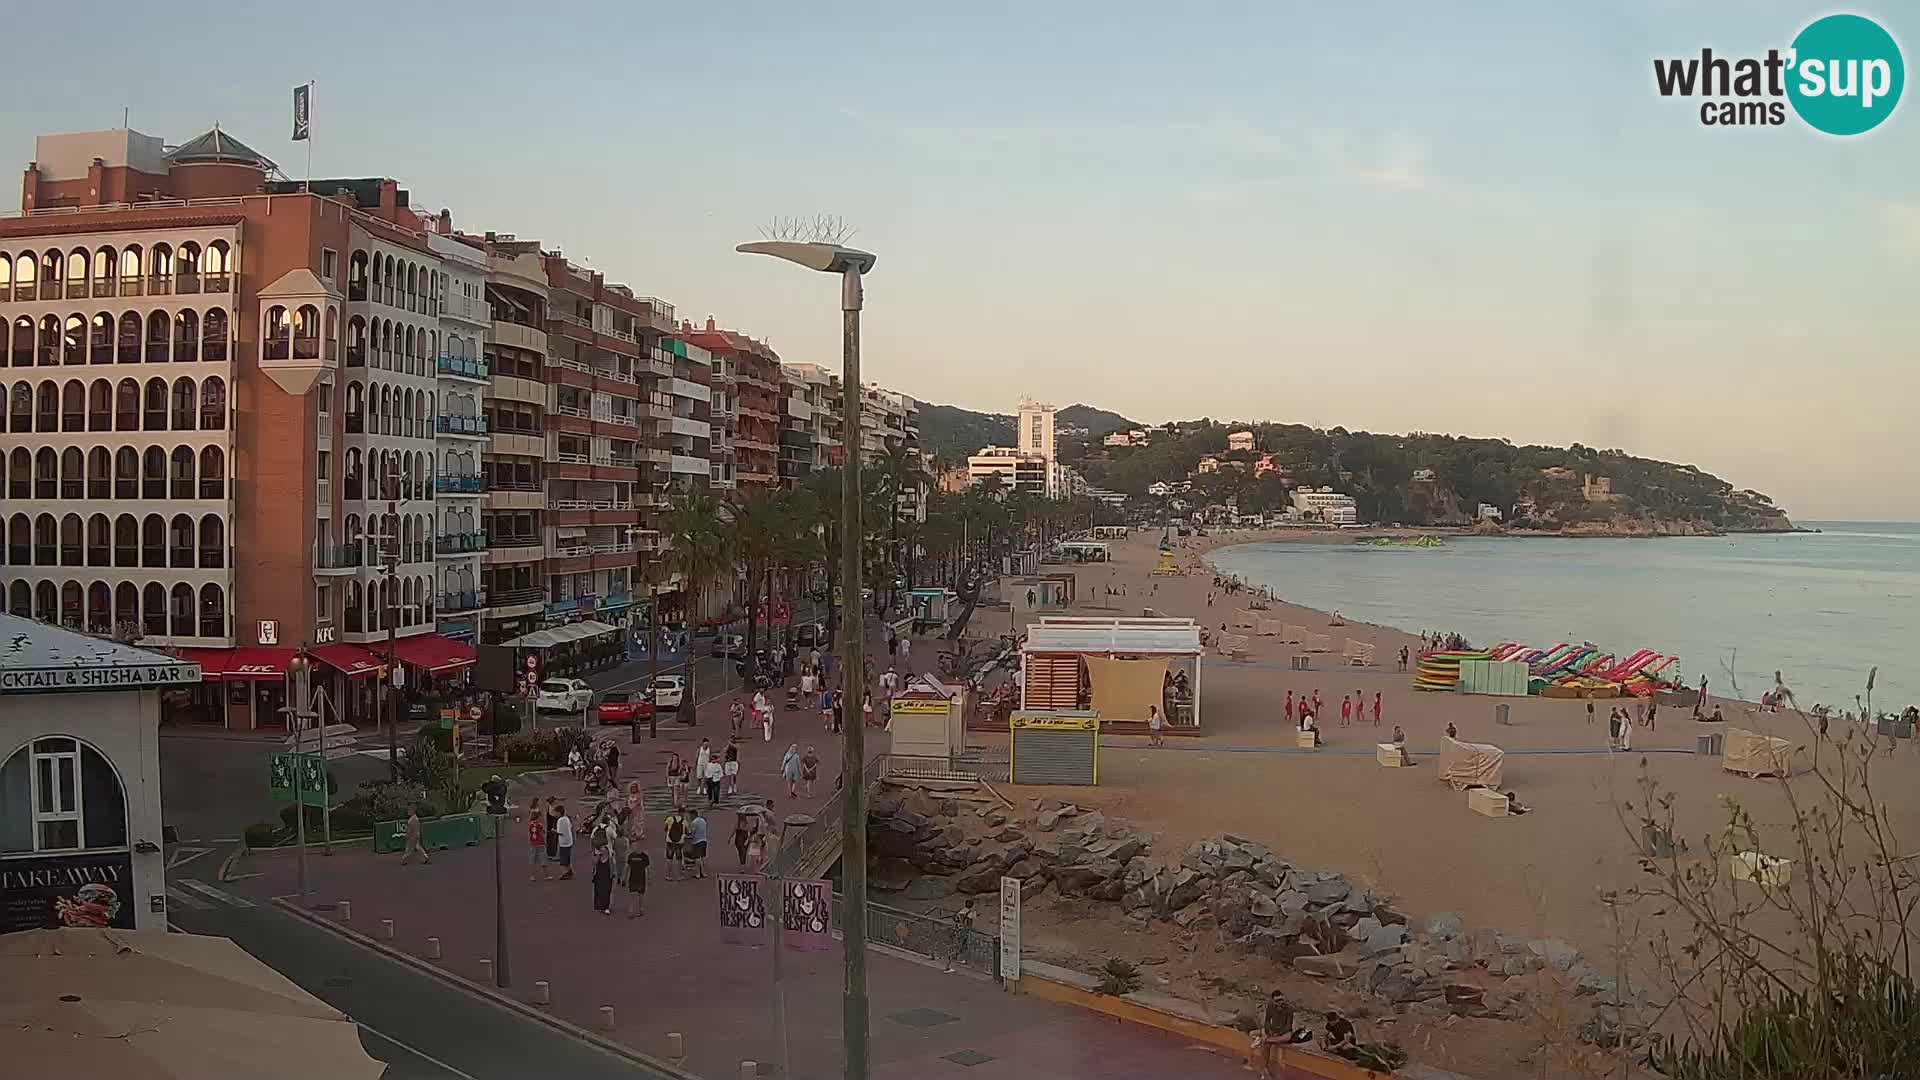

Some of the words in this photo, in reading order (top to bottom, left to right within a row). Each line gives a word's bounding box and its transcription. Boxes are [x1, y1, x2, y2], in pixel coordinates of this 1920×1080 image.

[315, 627, 335, 644] KFC
[2, 672, 61, 687] CKTAIL
[65, 671, 77, 685] &
[81, 668, 143, 685] SHISHA
[148, 667, 181, 682] BAR
[238, 664, 275, 672] KFC
[0, 865, 123, 889] TAKEAWAY
